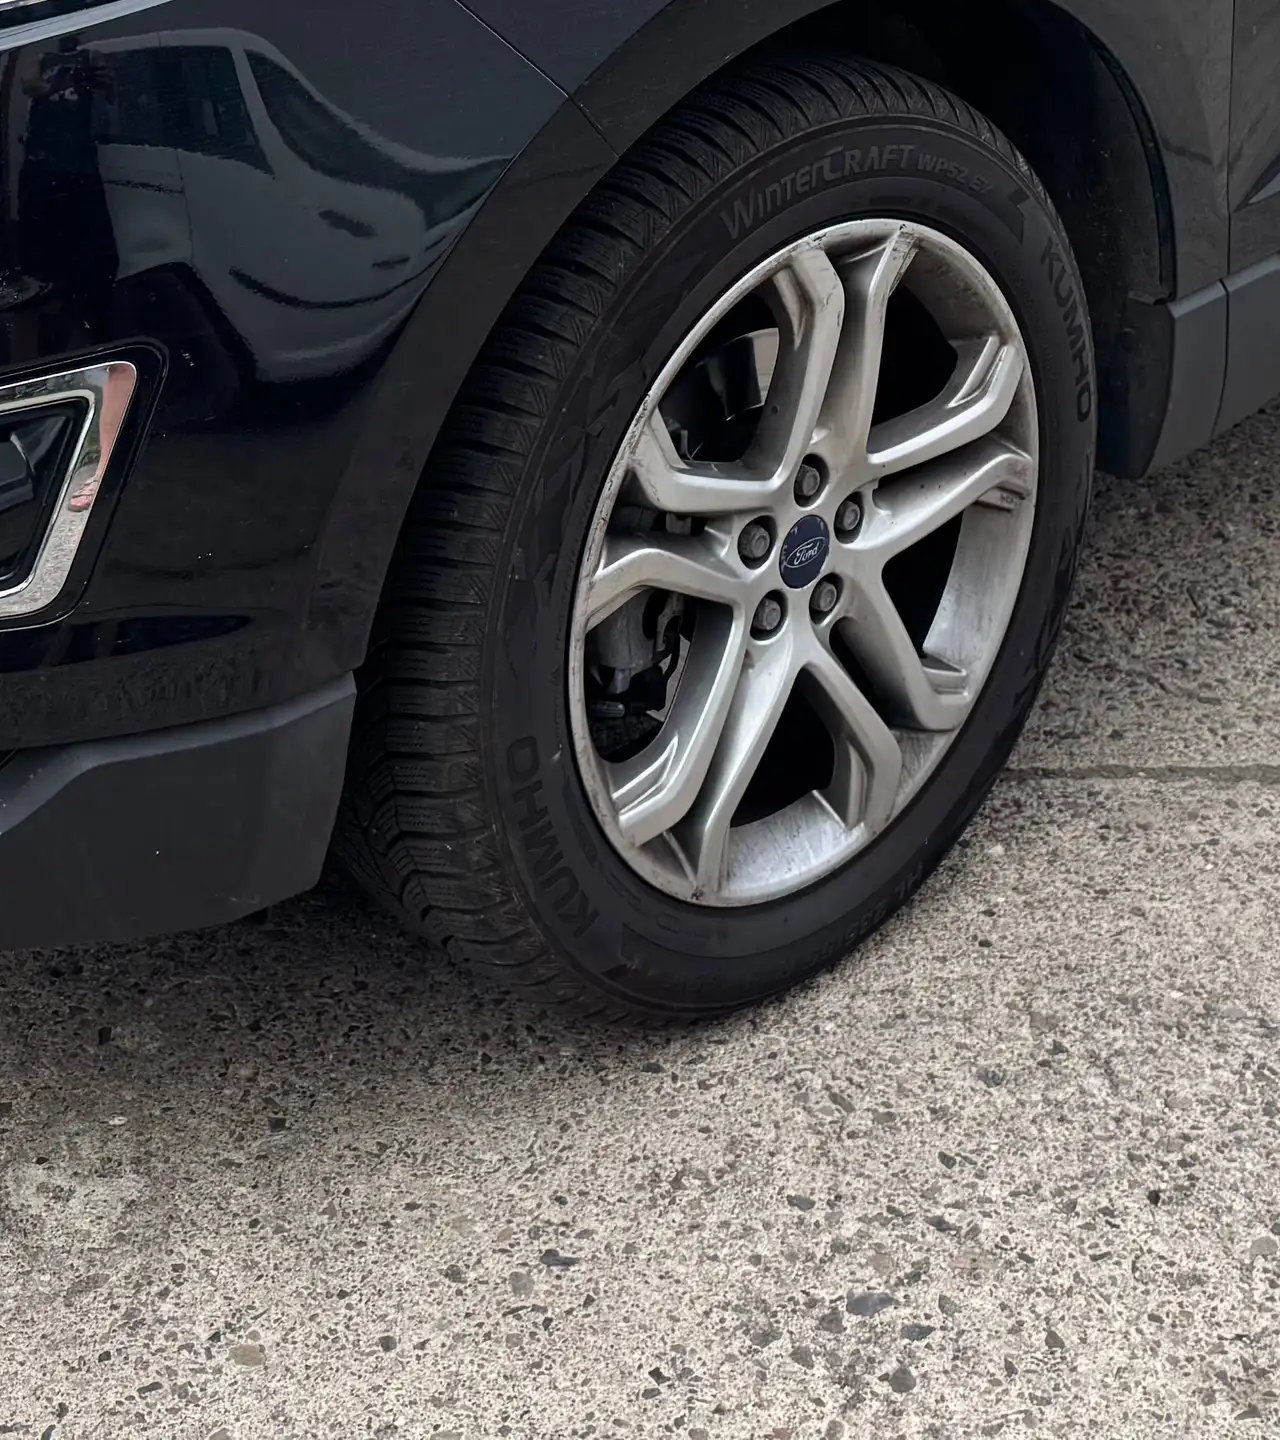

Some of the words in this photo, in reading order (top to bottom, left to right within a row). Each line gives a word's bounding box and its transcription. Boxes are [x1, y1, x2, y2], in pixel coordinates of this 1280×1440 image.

[1040, 236, 1092, 423] KUMHO
[793, 541, 820, 566] Ford
[506, 736, 601, 940] KUMHO
